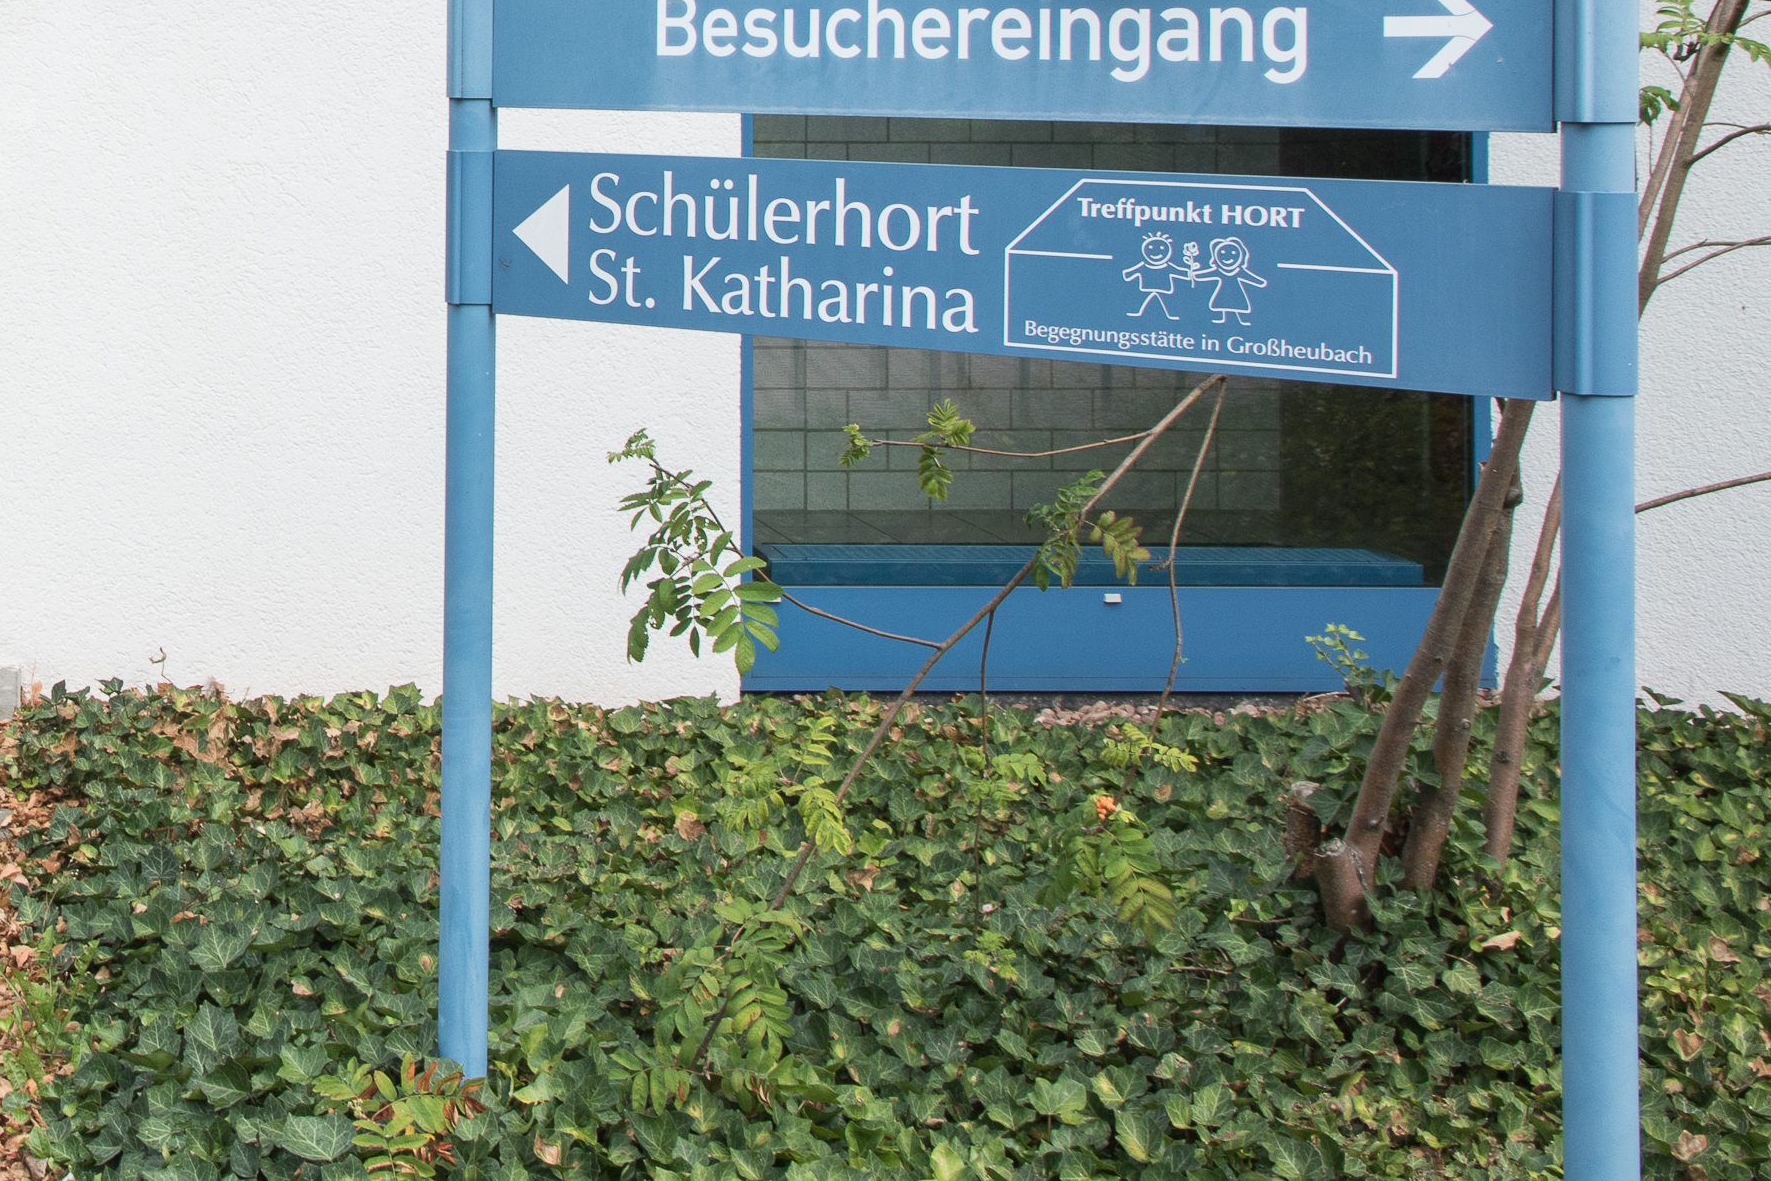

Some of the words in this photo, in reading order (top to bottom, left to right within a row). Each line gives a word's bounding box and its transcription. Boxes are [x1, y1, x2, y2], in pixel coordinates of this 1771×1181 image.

[589, 170, 981, 256] Schülerhort
[1077, 196, 1213, 227] Treffpunkt
[1221, 204, 1306, 229] HORT
[588, 248, 657, 310] St.
[683, 253, 980, 334] Katharina
[1024, 319, 1196, 352] Begegnungsstätte
[1200, 333, 1220, 352] in
[1226, 335, 1373, 365] Großheubach
